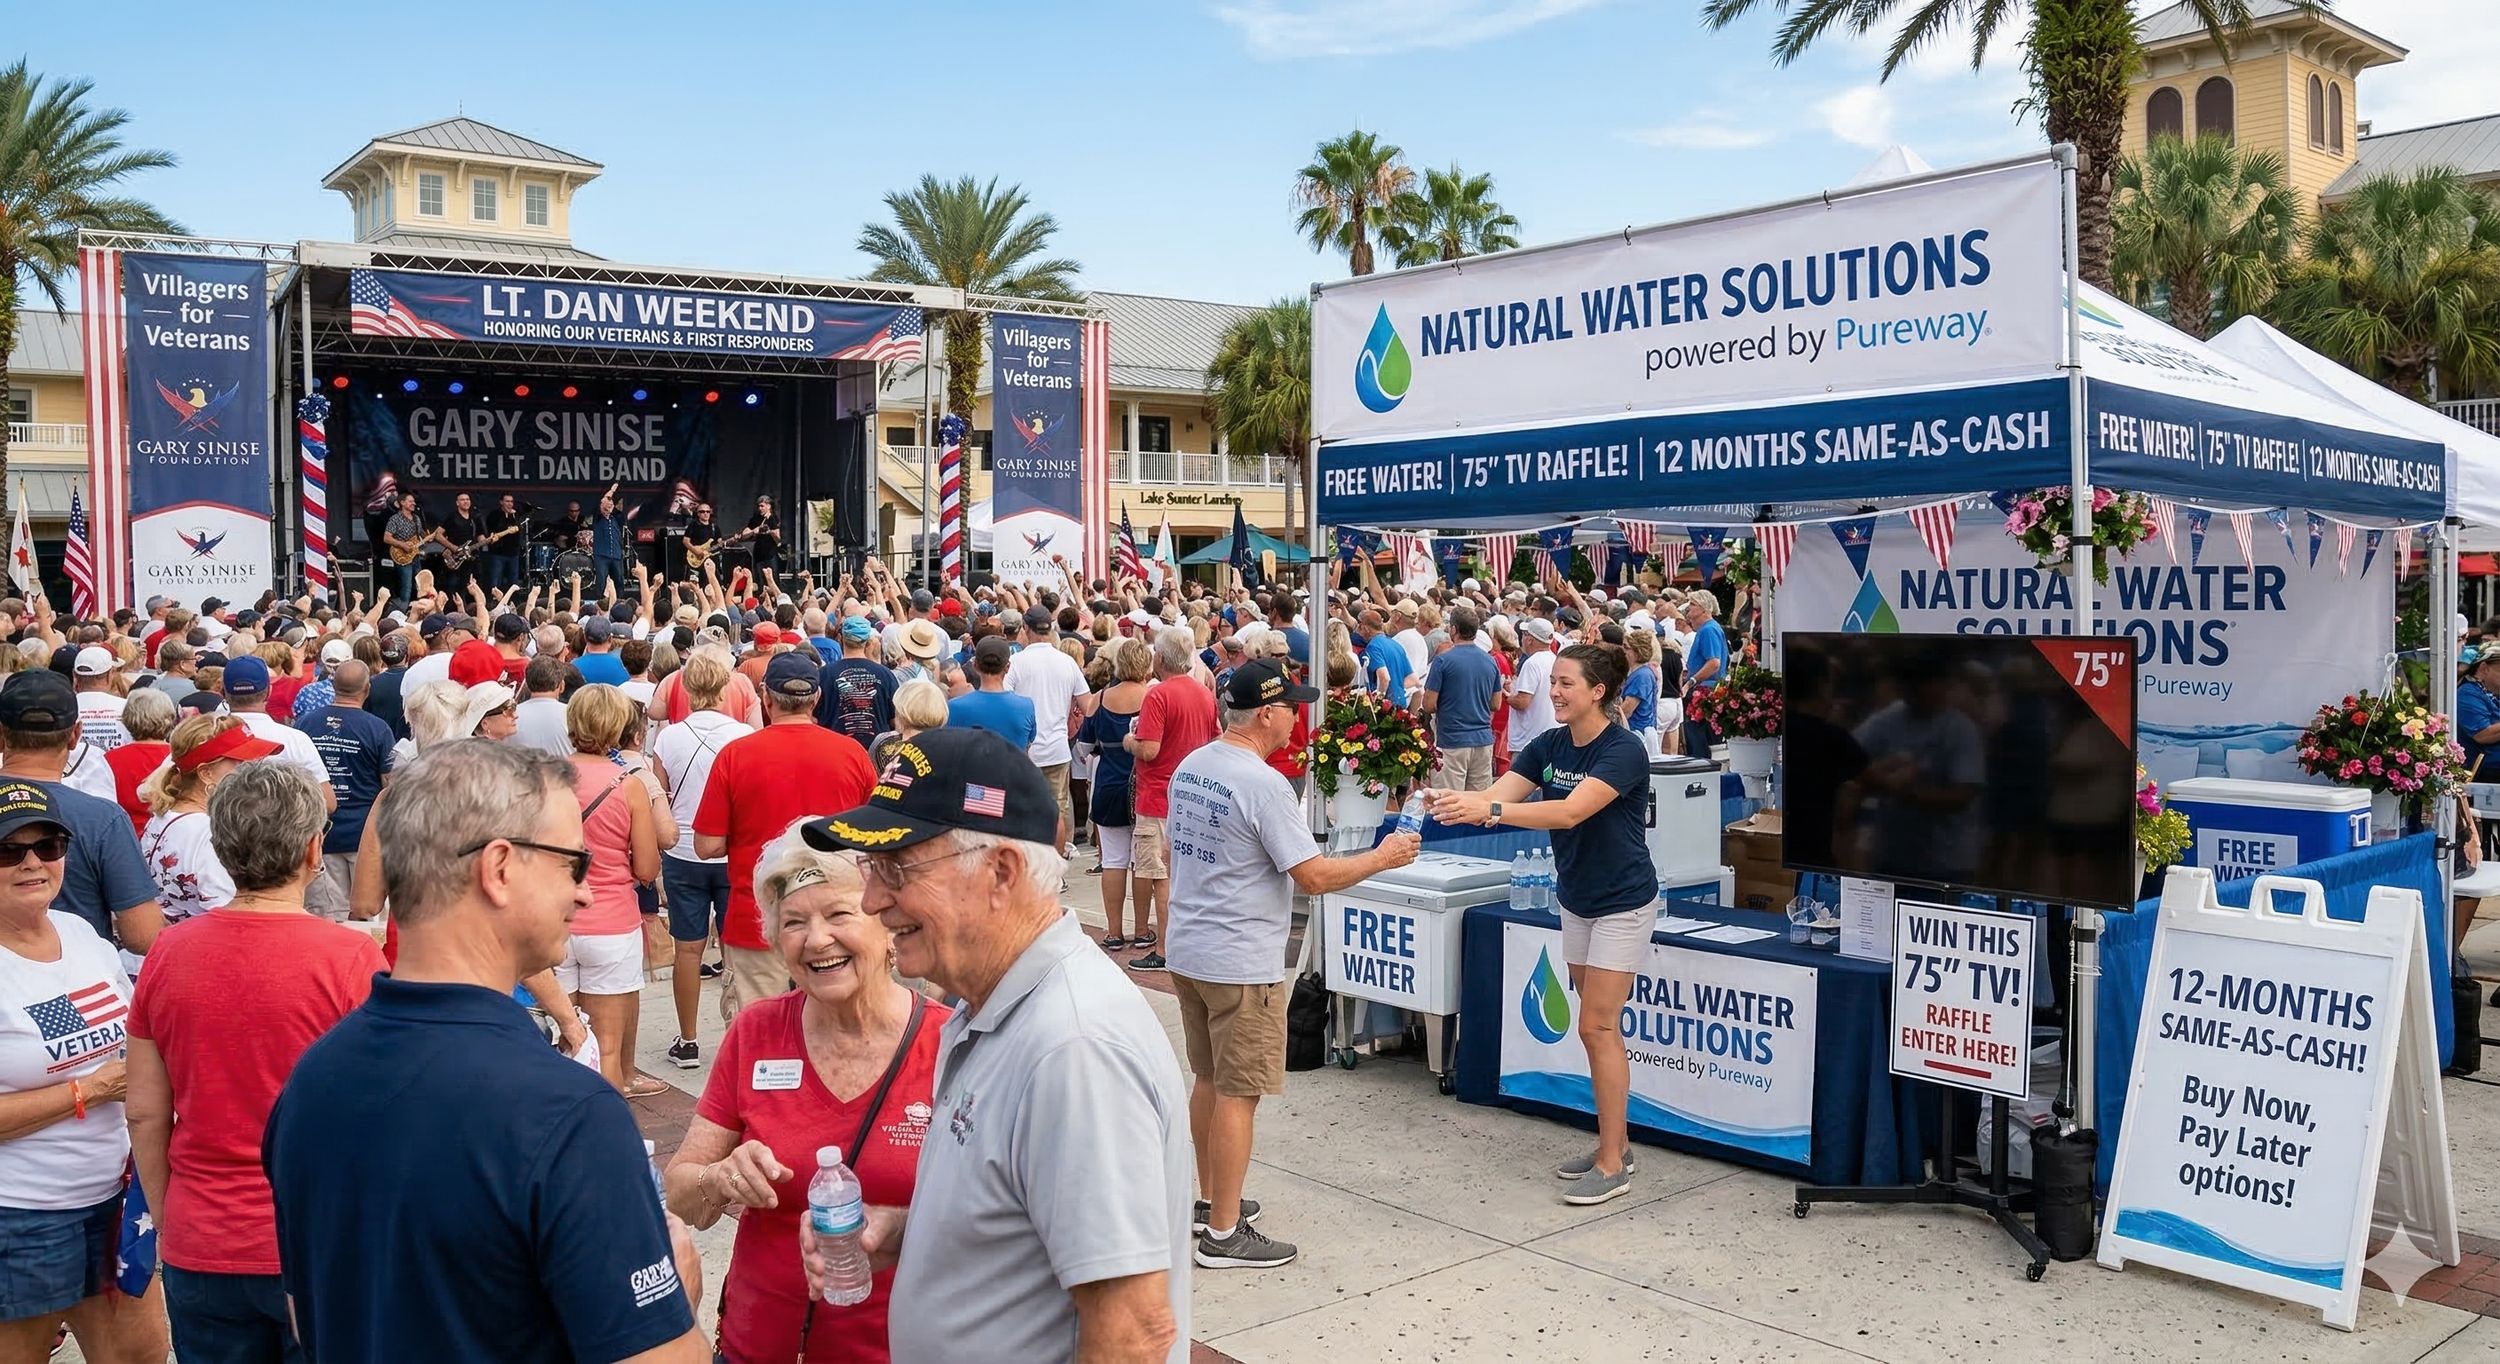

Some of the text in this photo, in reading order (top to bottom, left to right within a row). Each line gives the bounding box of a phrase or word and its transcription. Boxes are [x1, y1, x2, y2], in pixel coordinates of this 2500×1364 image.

[143, 273, 249, 304] Villagers
[1421, 229, 1991, 357] NATURAL WATER SOLUTIONS
[180, 302, 214, 324] for
[483, 285, 815, 334] LT. DAN WEEKEND
[144, 325, 250, 351] Veterans
[484, 321, 814, 352] HONORING OUR VETERANS & FIRST RESPONDERS
[1003, 328, 1072, 353] Villagers
[1646, 325, 1776, 380] powered
[1788, 323, 1827, 363] by
[1027, 351, 1050, 368] for
[1003, 368, 1072, 389] Veterans
[409, 407, 666, 452] GARY SINISE
[137, 440, 260, 456] GARY SINISE
[150, 455, 250, 465] FOUNDATION
[997, 458, 1077, 471] GARY SINISE
[1325, 410, 2050, 497] FREE WATER! 75" TV RAFFLE! 12 MONTHS SAME-AS-CASH
[2099, 411, 2441, 493] FREE WATER! 75" TV RAFFLE! 12 MONTHS SAME-AS-CASH
[410, 452, 666, 482] & THE LT. DAN BAND
[1005, 471, 1071, 479] FOUNDATION
[1140, 491, 1164, 505] Lake
[148, 564, 256, 577] GARY SINISE
[159, 577, 248, 585] FOUNDATION
[1001, 559, 1032, 569] GARY
[1900, 565, 2287, 611] NATURA WATER
[2073, 651, 2126, 687] 75"
[2144, 674, 2233, 702] Pureway
[2218, 838, 2276, 866] FREE
[1344, 907, 1415, 959] FREE
[1908, 915, 1958, 949] WIN
[1965, 923, 2020, 957] THIS
[1342, 952, 1415, 994] WATER
[1905, 952, 2021, 1007] 75" TV!
[1694, 983, 1795, 1030] WATER
[2169, 967, 2374, 1031] 12-MONTHS
[1620, 1006, 1773, 1065] OLUTIONS
[1926, 1003, 1992, 1034] RAFFLE
[45, 1020, 126, 1061] VETERA
[1902, 1027, 2017, 1067] ENTER HERE!
[2159, 1012, 2368, 1073] SAME-AS-CASH!
[1688, 1057, 1705, 1079] by
[1709, 1062, 1773, 1093] Pureway
[2182, 1074, 2317, 1133] Buy Now,
[2179, 1114, 2312, 1167] Pay Later
[2179, 1162, 2295, 1208] options!
